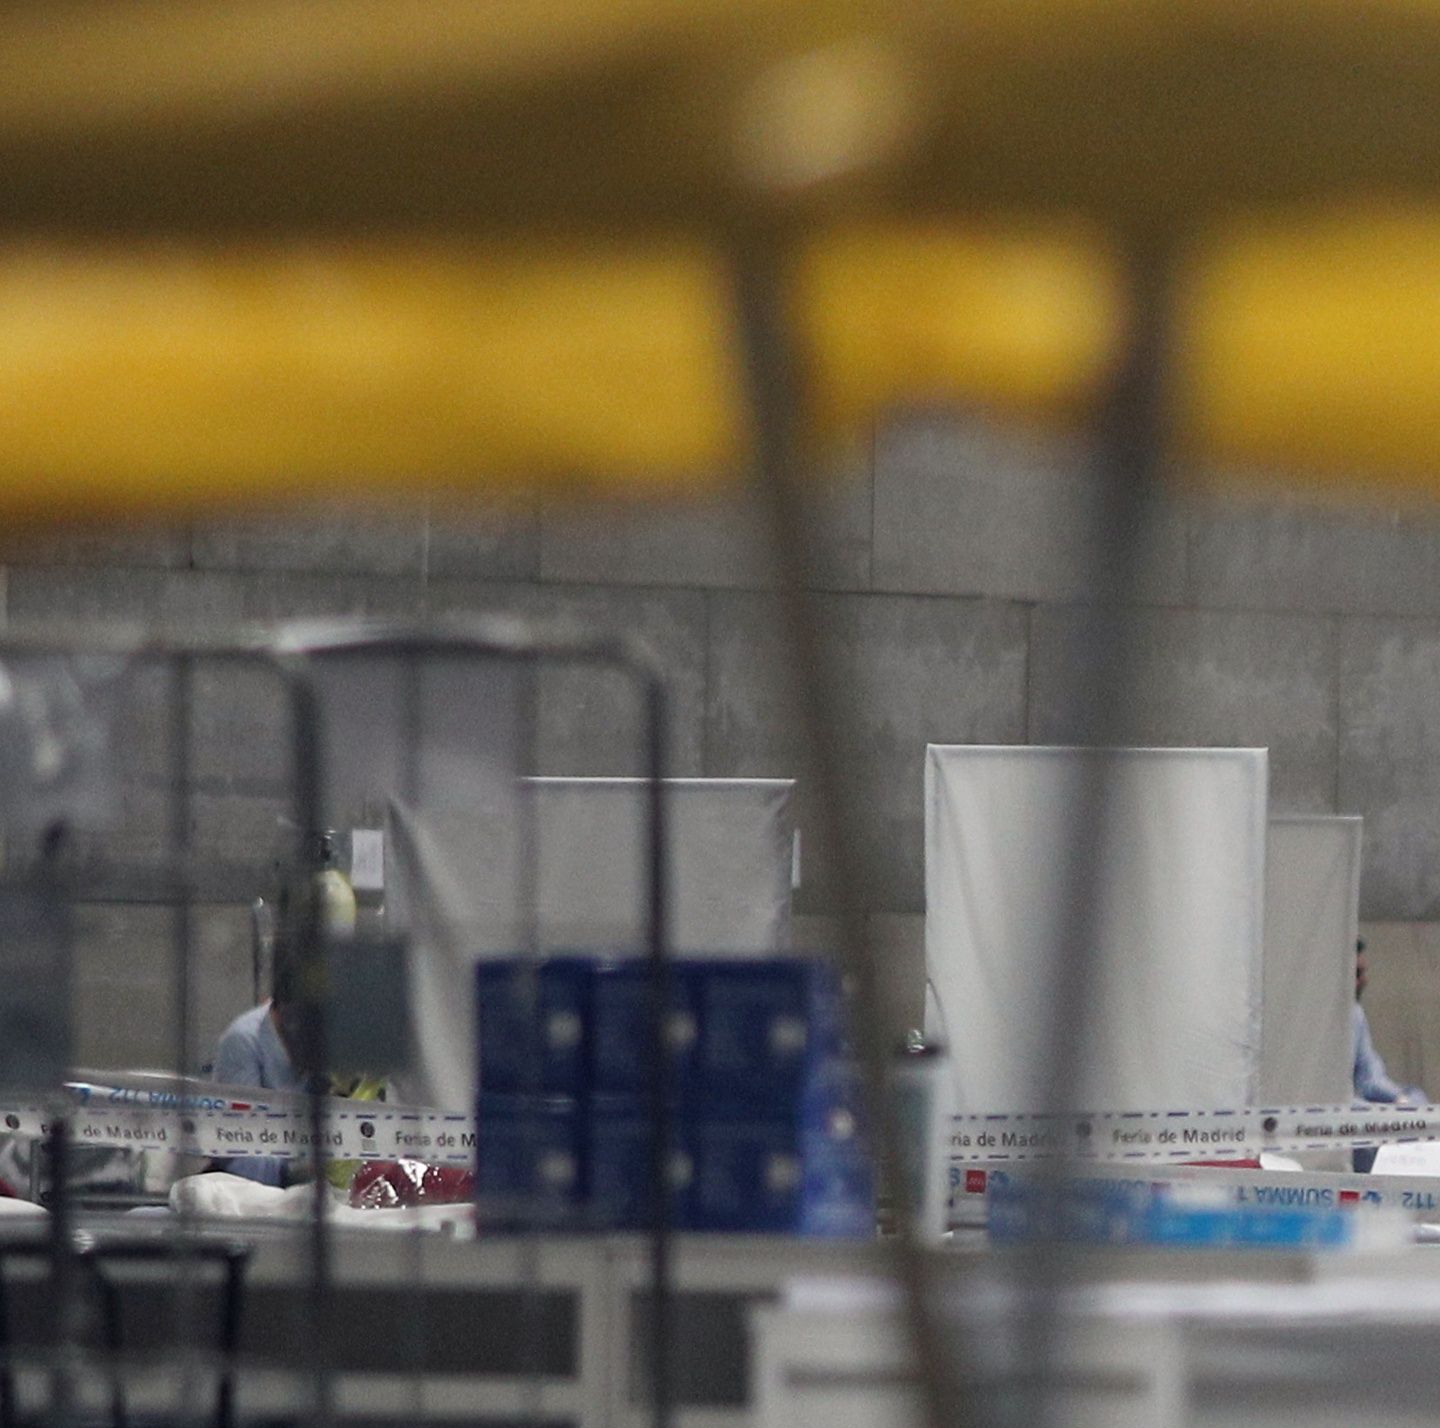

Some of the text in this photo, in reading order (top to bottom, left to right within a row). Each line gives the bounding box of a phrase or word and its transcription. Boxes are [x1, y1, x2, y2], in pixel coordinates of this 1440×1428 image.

[216, 1127, 253, 1142] Feria
[260, 1129, 277, 1144] de
[396, 1131, 431, 1146] Feria
[438, 1132, 455, 1147] de
[951, 1132, 971, 1147] ria
[977, 1130, 996, 1147] de
[1113, 1128, 1246, 1144] Feria de Madrid
[1254, 1185, 1332, 1207] SUMMA
[1401, 1191, 1436, 1211] 112
